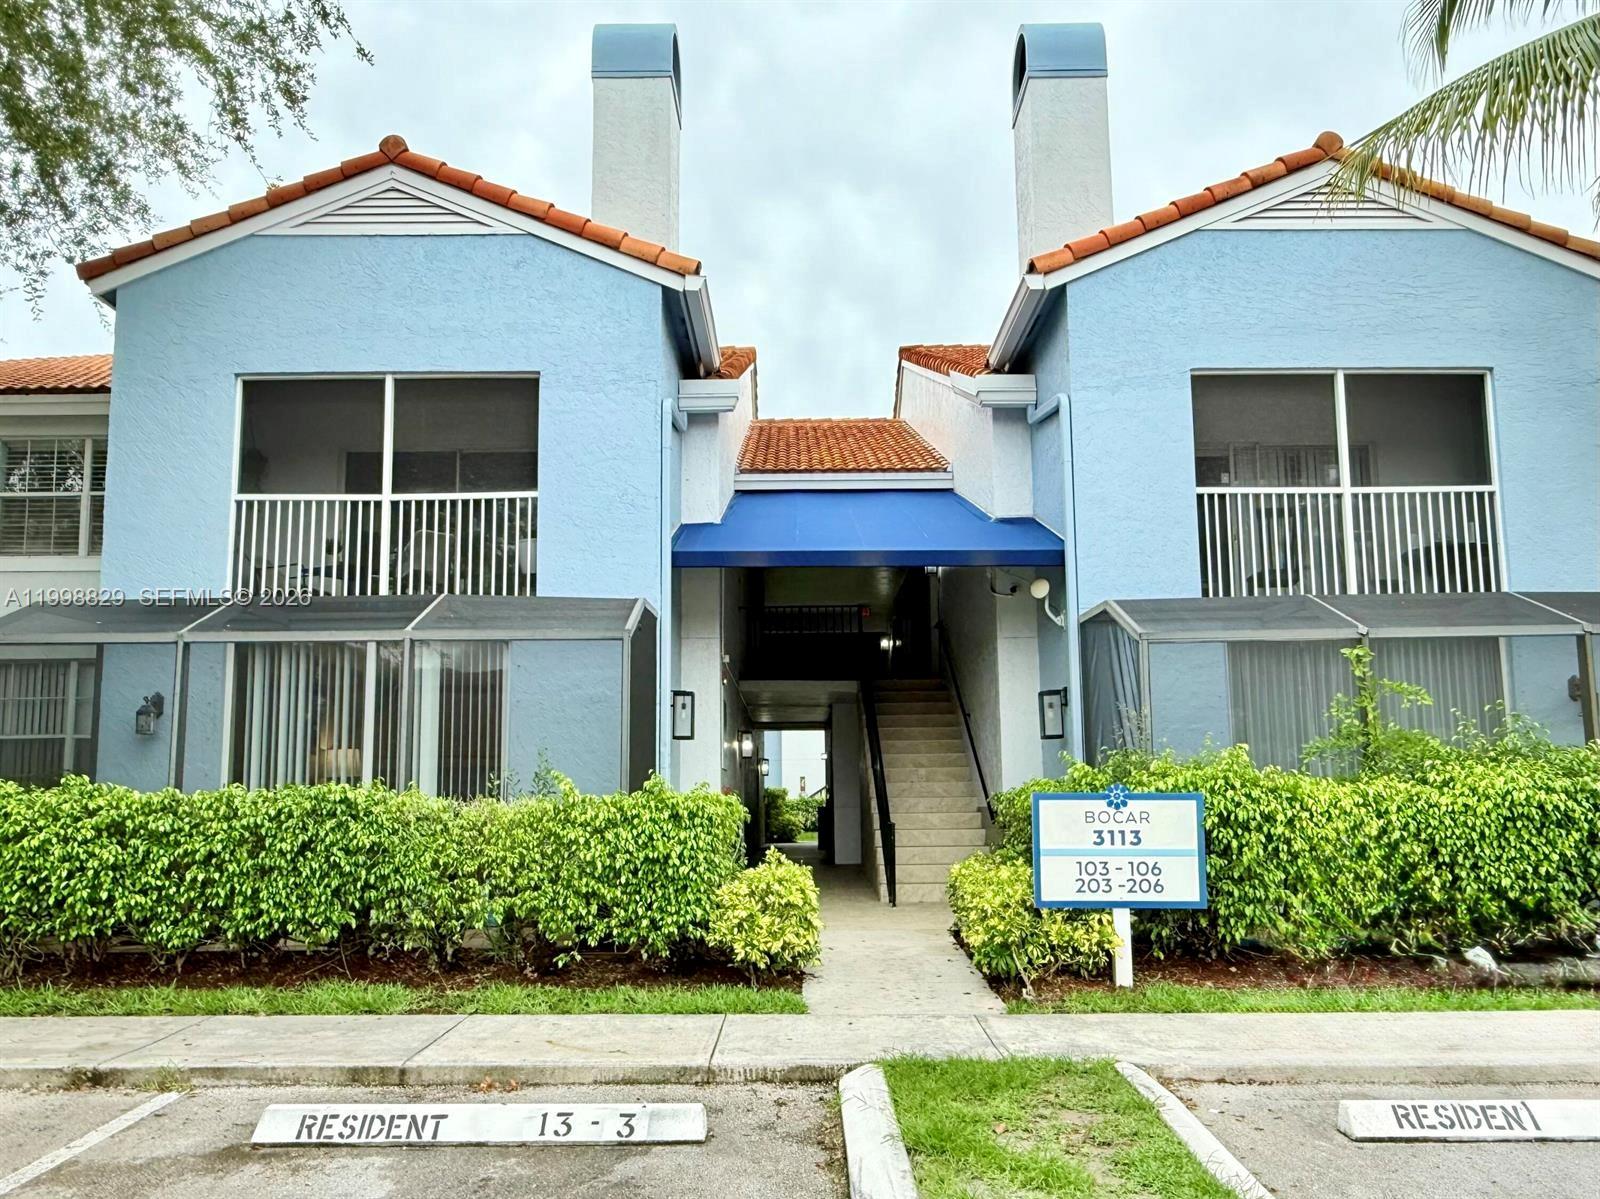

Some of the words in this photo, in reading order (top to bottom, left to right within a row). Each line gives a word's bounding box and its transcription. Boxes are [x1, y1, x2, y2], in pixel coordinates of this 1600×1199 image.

[1084, 810, 1151, 824] BOCAR
[1092, 829, 1142, 847] 3113
[295, 1113, 449, 1141] RESIDENT
